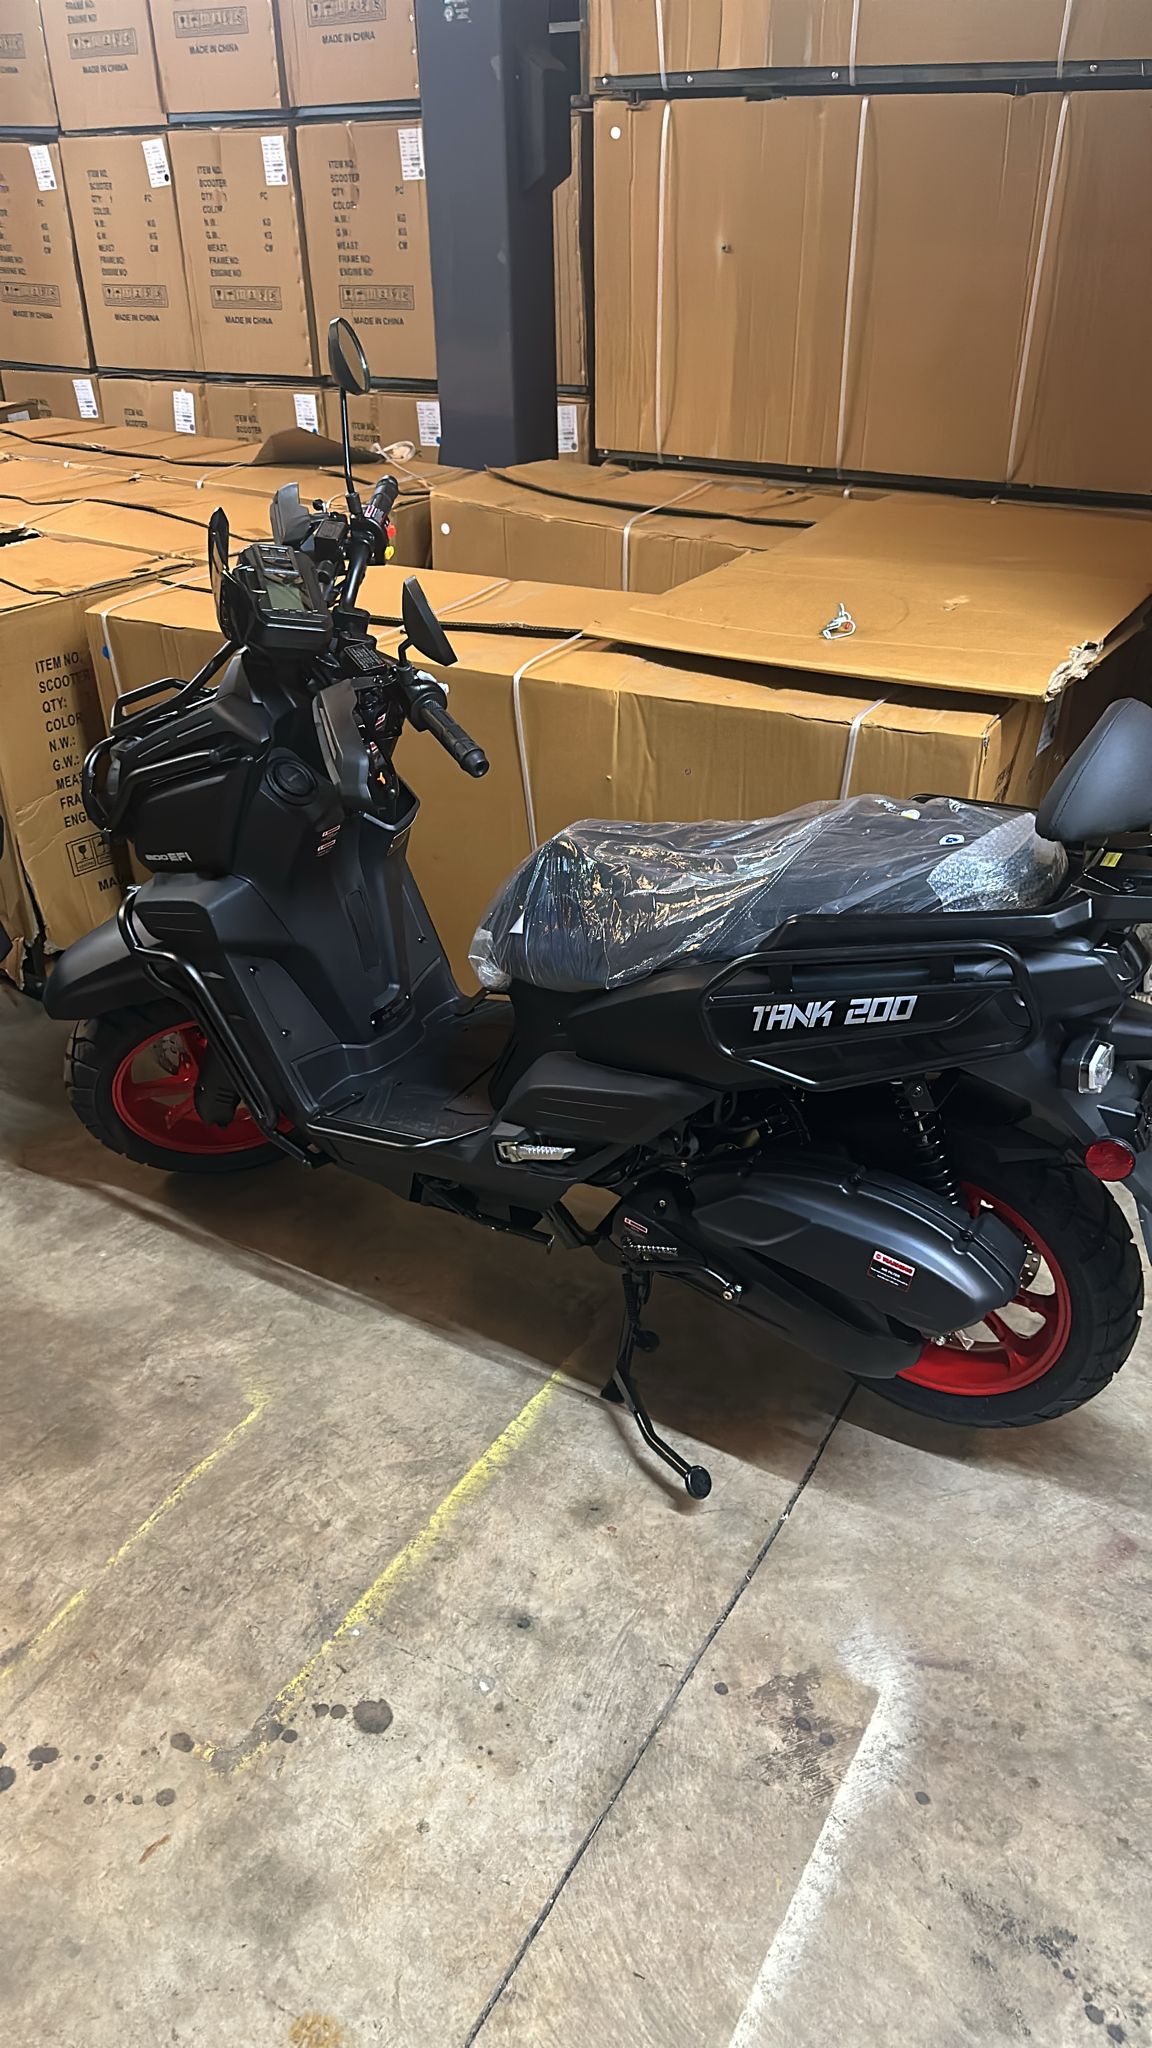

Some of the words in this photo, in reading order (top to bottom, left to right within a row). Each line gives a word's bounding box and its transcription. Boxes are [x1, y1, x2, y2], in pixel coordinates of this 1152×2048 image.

[322, 34, 343, 44] MADE
[344, 33, 352, 42] IN
[352, 31, 376, 41] CHINA
[189, 46, 210, 55] MADE
[210, 45, 217, 54] IN
[218, 43, 239, 53] CHINA
[108, 64, 128, 72] CHINA
[225, 316, 244, 324] MADE
[353, 316, 373, 325] MADE
[374, 317, 382, 325] IN
[382, 317, 404, 325] CHINA
[35, 656, 61, 674] ITEM
[42, 697, 67, 713] QTY:
[49, 736, 76, 752] N.W.:
[52, 755, 80, 771] G.W.:
[55, 773, 83, 791] MEAS
[60, 794, 83, 810] FRA
[64, 811, 87, 828] ENG
[752, 1000, 836, 1032] TANK
[843, 995, 918, 1025] 200
